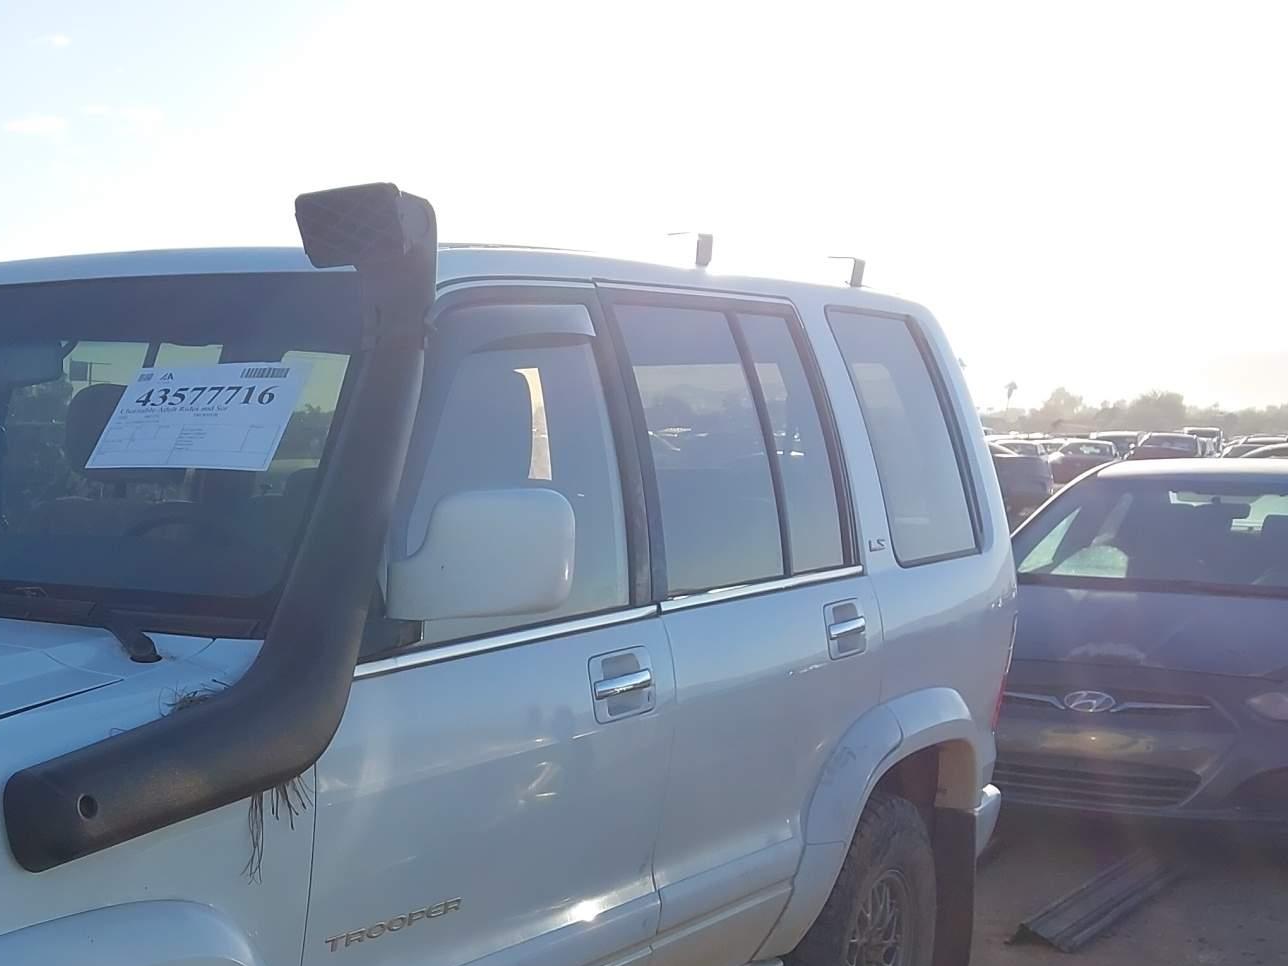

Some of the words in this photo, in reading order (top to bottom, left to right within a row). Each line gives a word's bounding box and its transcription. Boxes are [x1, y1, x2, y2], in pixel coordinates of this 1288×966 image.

[136, 385, 280, 406] 43577716
[868, 539, 887, 552] LS
[325, 897, 463, 953] TROOPER
